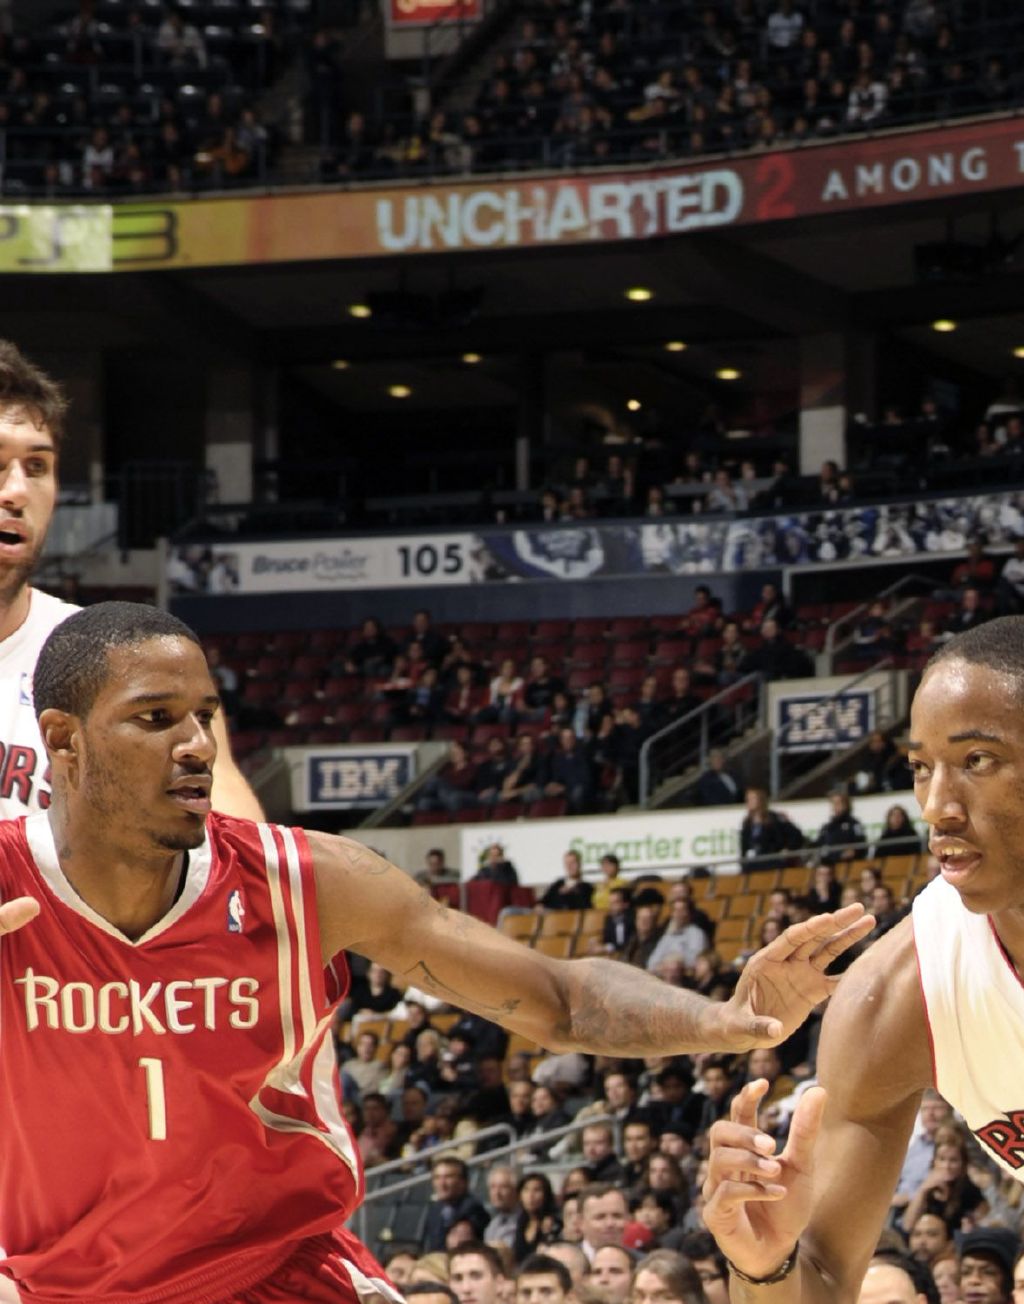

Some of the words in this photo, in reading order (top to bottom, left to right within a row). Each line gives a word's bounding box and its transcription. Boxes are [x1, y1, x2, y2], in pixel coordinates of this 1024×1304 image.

[376, 168, 744, 249] UNCHARTED
[821, 147, 988, 202] AMONG
[252, 554, 310, 575] Bruce
[397, 543, 464, 578] 105
[787, 698, 863, 743] IBM
[318, 759, 401, 799] IBM
[568, 831, 682, 864] Smarter
[14, 966, 261, 1037] ROCKETS
[139, 1057, 167, 1141] 1
